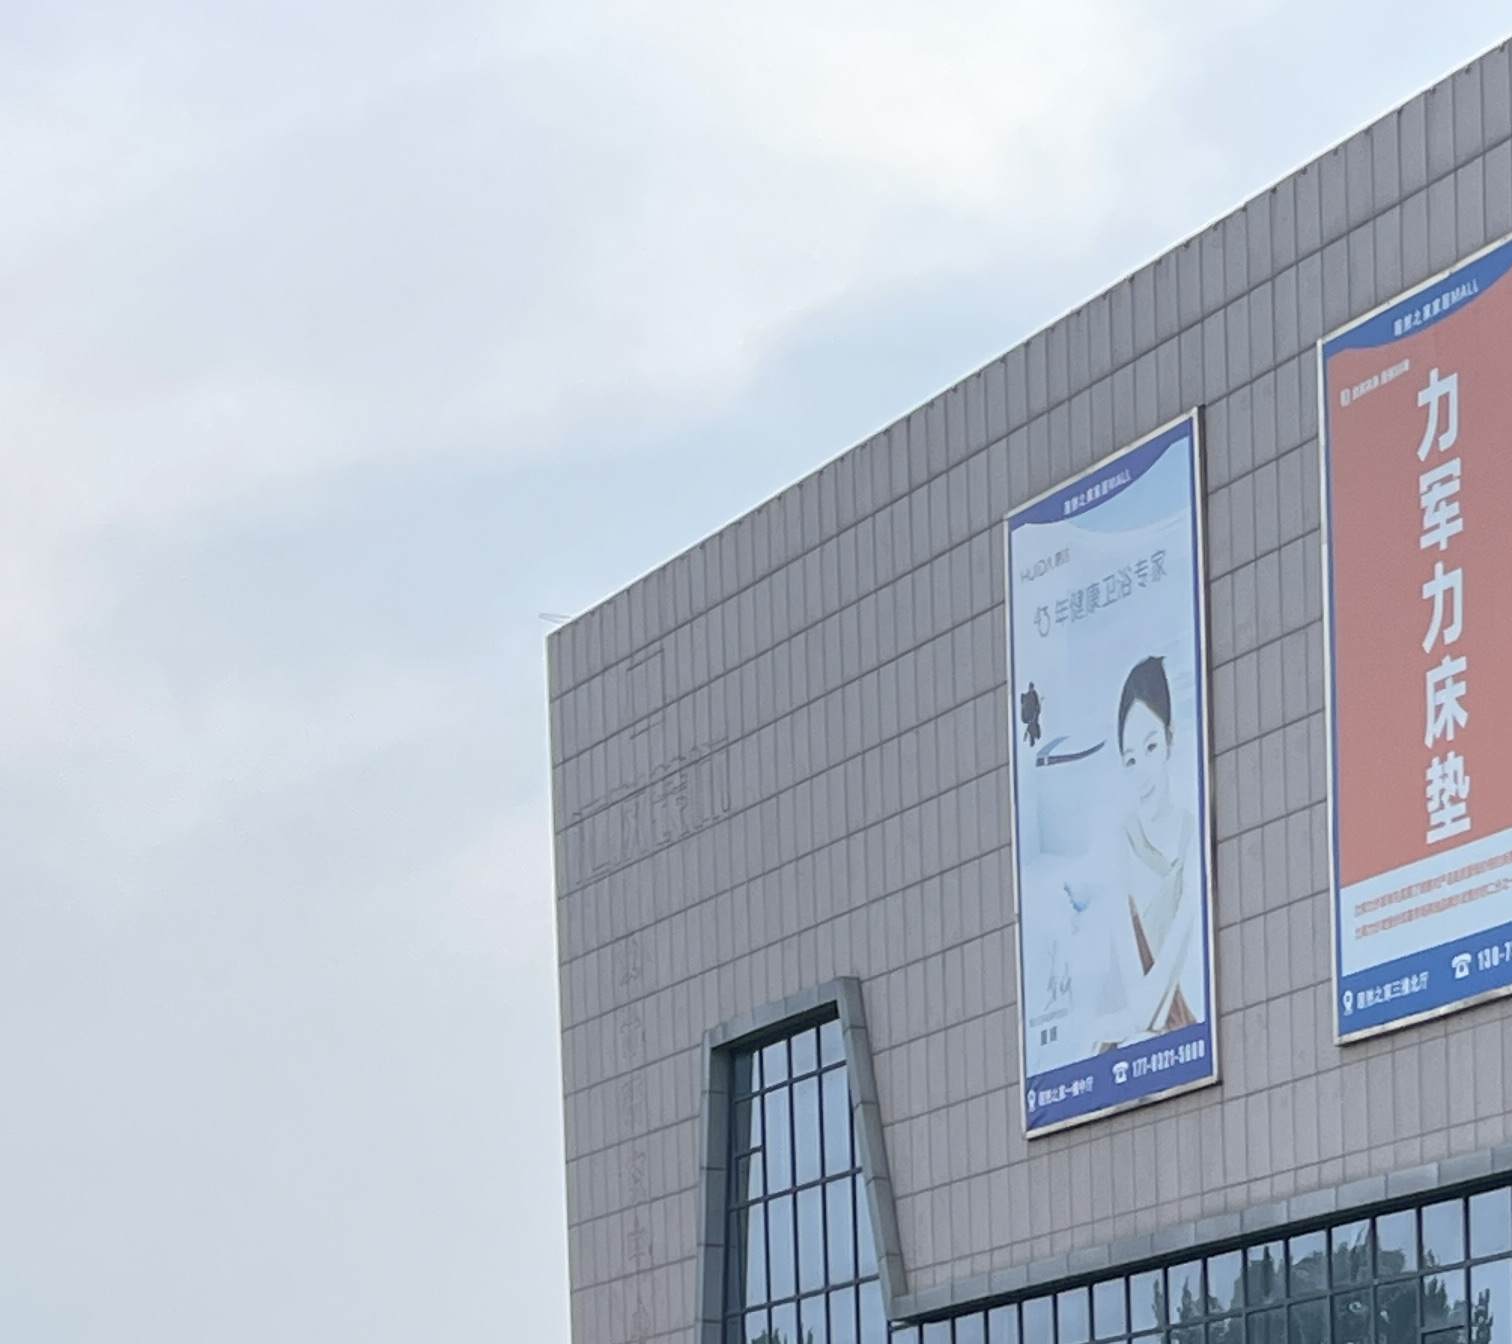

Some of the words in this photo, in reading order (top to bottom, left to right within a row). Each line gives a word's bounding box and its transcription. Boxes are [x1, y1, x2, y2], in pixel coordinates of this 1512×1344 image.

[1416, 367, 1471, 845] 力军力床垫
